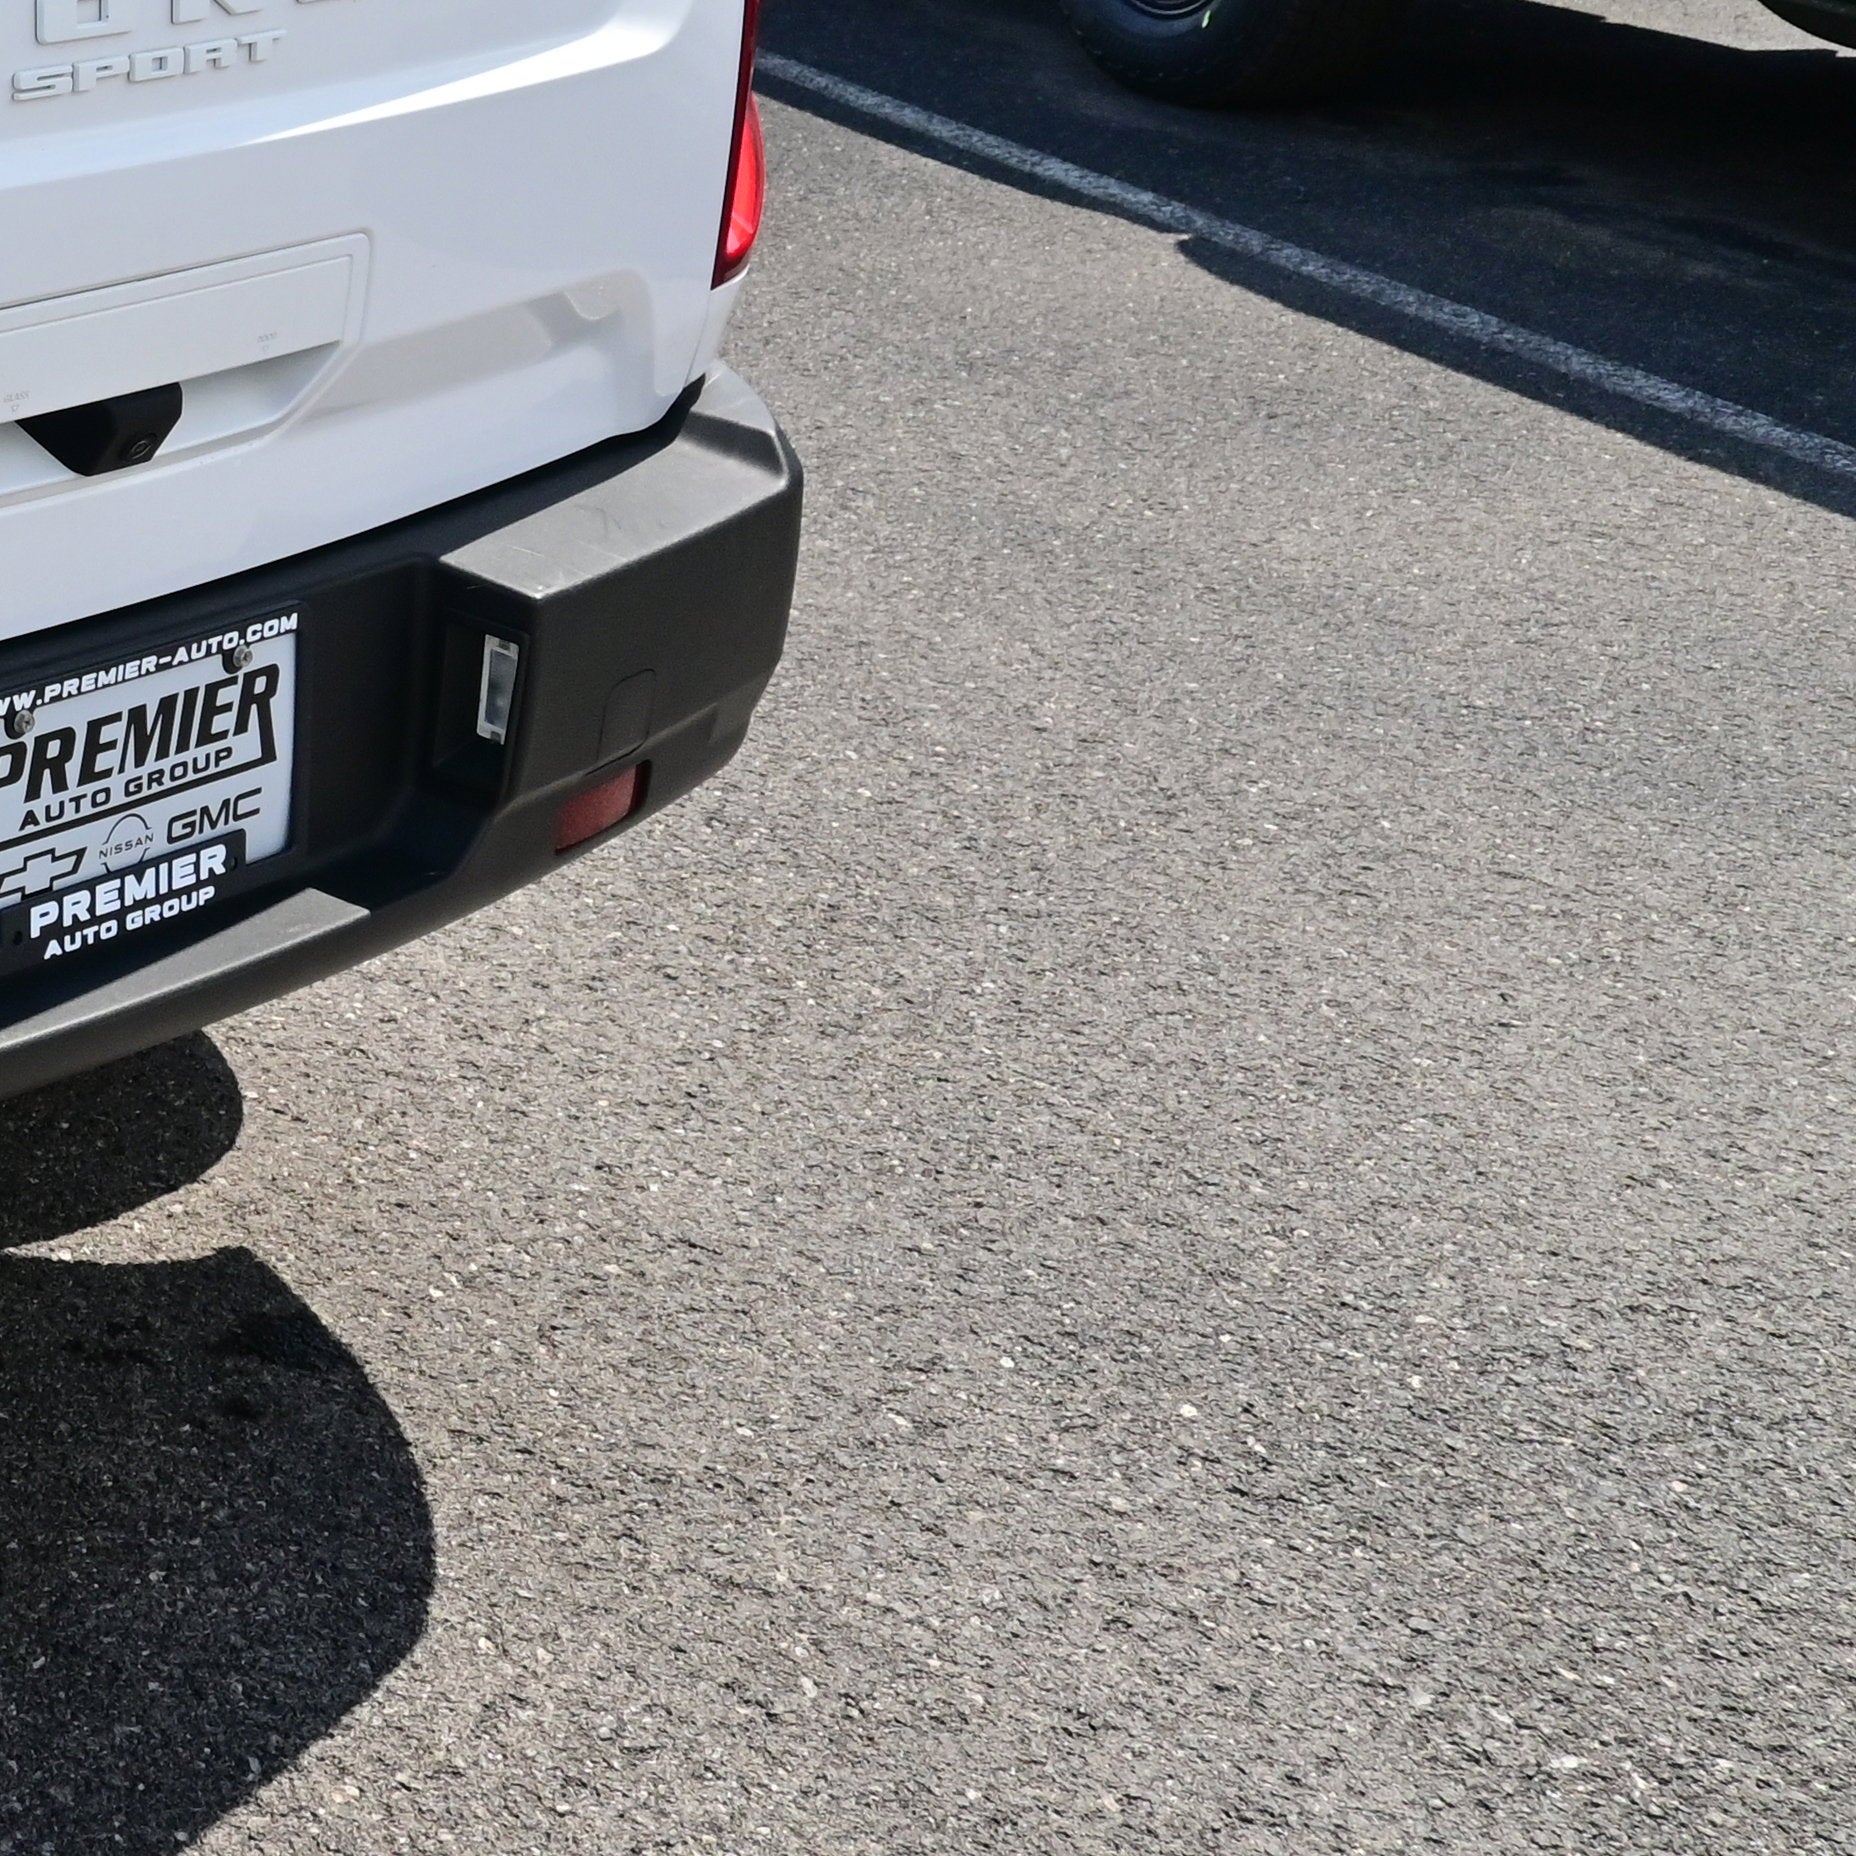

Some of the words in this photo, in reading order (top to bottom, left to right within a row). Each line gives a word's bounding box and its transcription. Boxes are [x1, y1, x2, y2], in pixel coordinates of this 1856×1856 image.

[11, 28, 287, 101] SPORT
[18, 787, 112, 832] AUTO
[123, 745, 234, 797] GROUP
[166, 787, 263, 845] GMC
[98, 833, 155, 860] NISSAN
[28, 844, 227, 940] PREMIER
[43, 920, 118, 960] AUTO
[125, 885, 216, 931] GROUP
